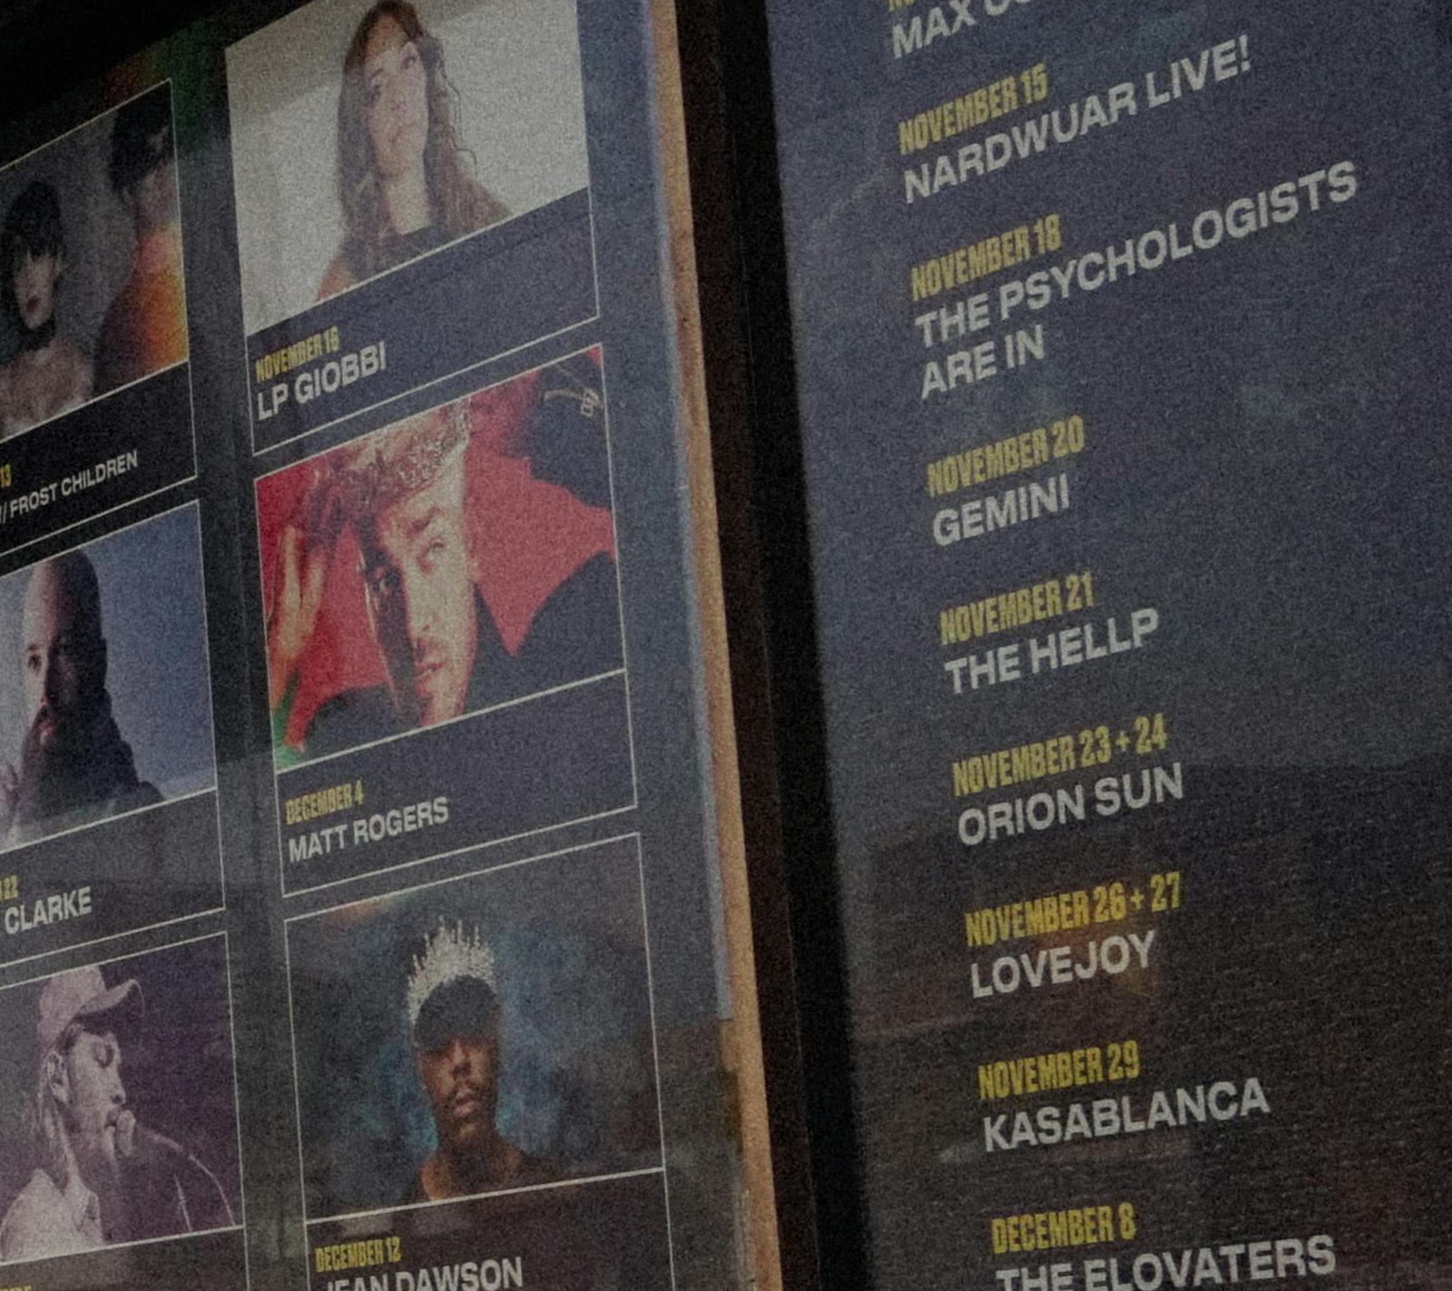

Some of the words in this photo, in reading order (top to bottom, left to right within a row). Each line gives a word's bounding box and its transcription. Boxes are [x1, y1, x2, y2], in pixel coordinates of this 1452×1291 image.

[904, 81, 1138, 204] NARDWUAR
[1146, 34, 1252, 108] LIVE!
[911, 223, 1031, 302] NOVEMBER
[1034, 213, 1063, 253] 18
[914, 290, 990, 349] THE
[999, 159, 1358, 321] PSYCHOLOGISTS
[256, 389, 290, 422] LP
[293, 339, 388, 404] GIOBBI
[921, 340, 997, 400] ARE
[1005, 324, 1047, 369] IN
[10, 482, 58, 519] FROST
[60, 448, 139, 500] CHILDREN
[927, 429, 1048, 499] NOVEMBER
[1049, 415, 1085, 458] 20
[932, 472, 1072, 547] GEMINI
[940, 583, 1063, 647] NOVEMBER
[1065, 571, 1096, 611] 21
[944, 644, 1022, 695] THE
[1030, 606, 1161, 677] HELLP
[953, 733, 1077, 798] NOVEMBER
[1079, 726, 1113, 768] 23
[1135, 712, 1168, 754] 24
[288, 829, 350, 865] MATT
[354, 796, 451, 846] ROGERS
[957, 783, 1085, 847] ORION
[1094, 762, 1185, 815] SUN
[4, 886, 93, 937] CLARKE
[965, 888, 1090, 947] NOVEMBER
[1093, 884, 1127, 924] 26
[1149, 870, 1181, 911] 27
[970, 929, 1157, 999] LOVEJOY
[978, 1047, 1104, 1100] NOVEMBER
[1106, 1039, 1141, 1081] 29
[982, 1078, 1271, 1153] KASABLANCA
[991, 1206, 1114, 1255] DECEMBER
[1116, 1202, 1137, 1242] 8
